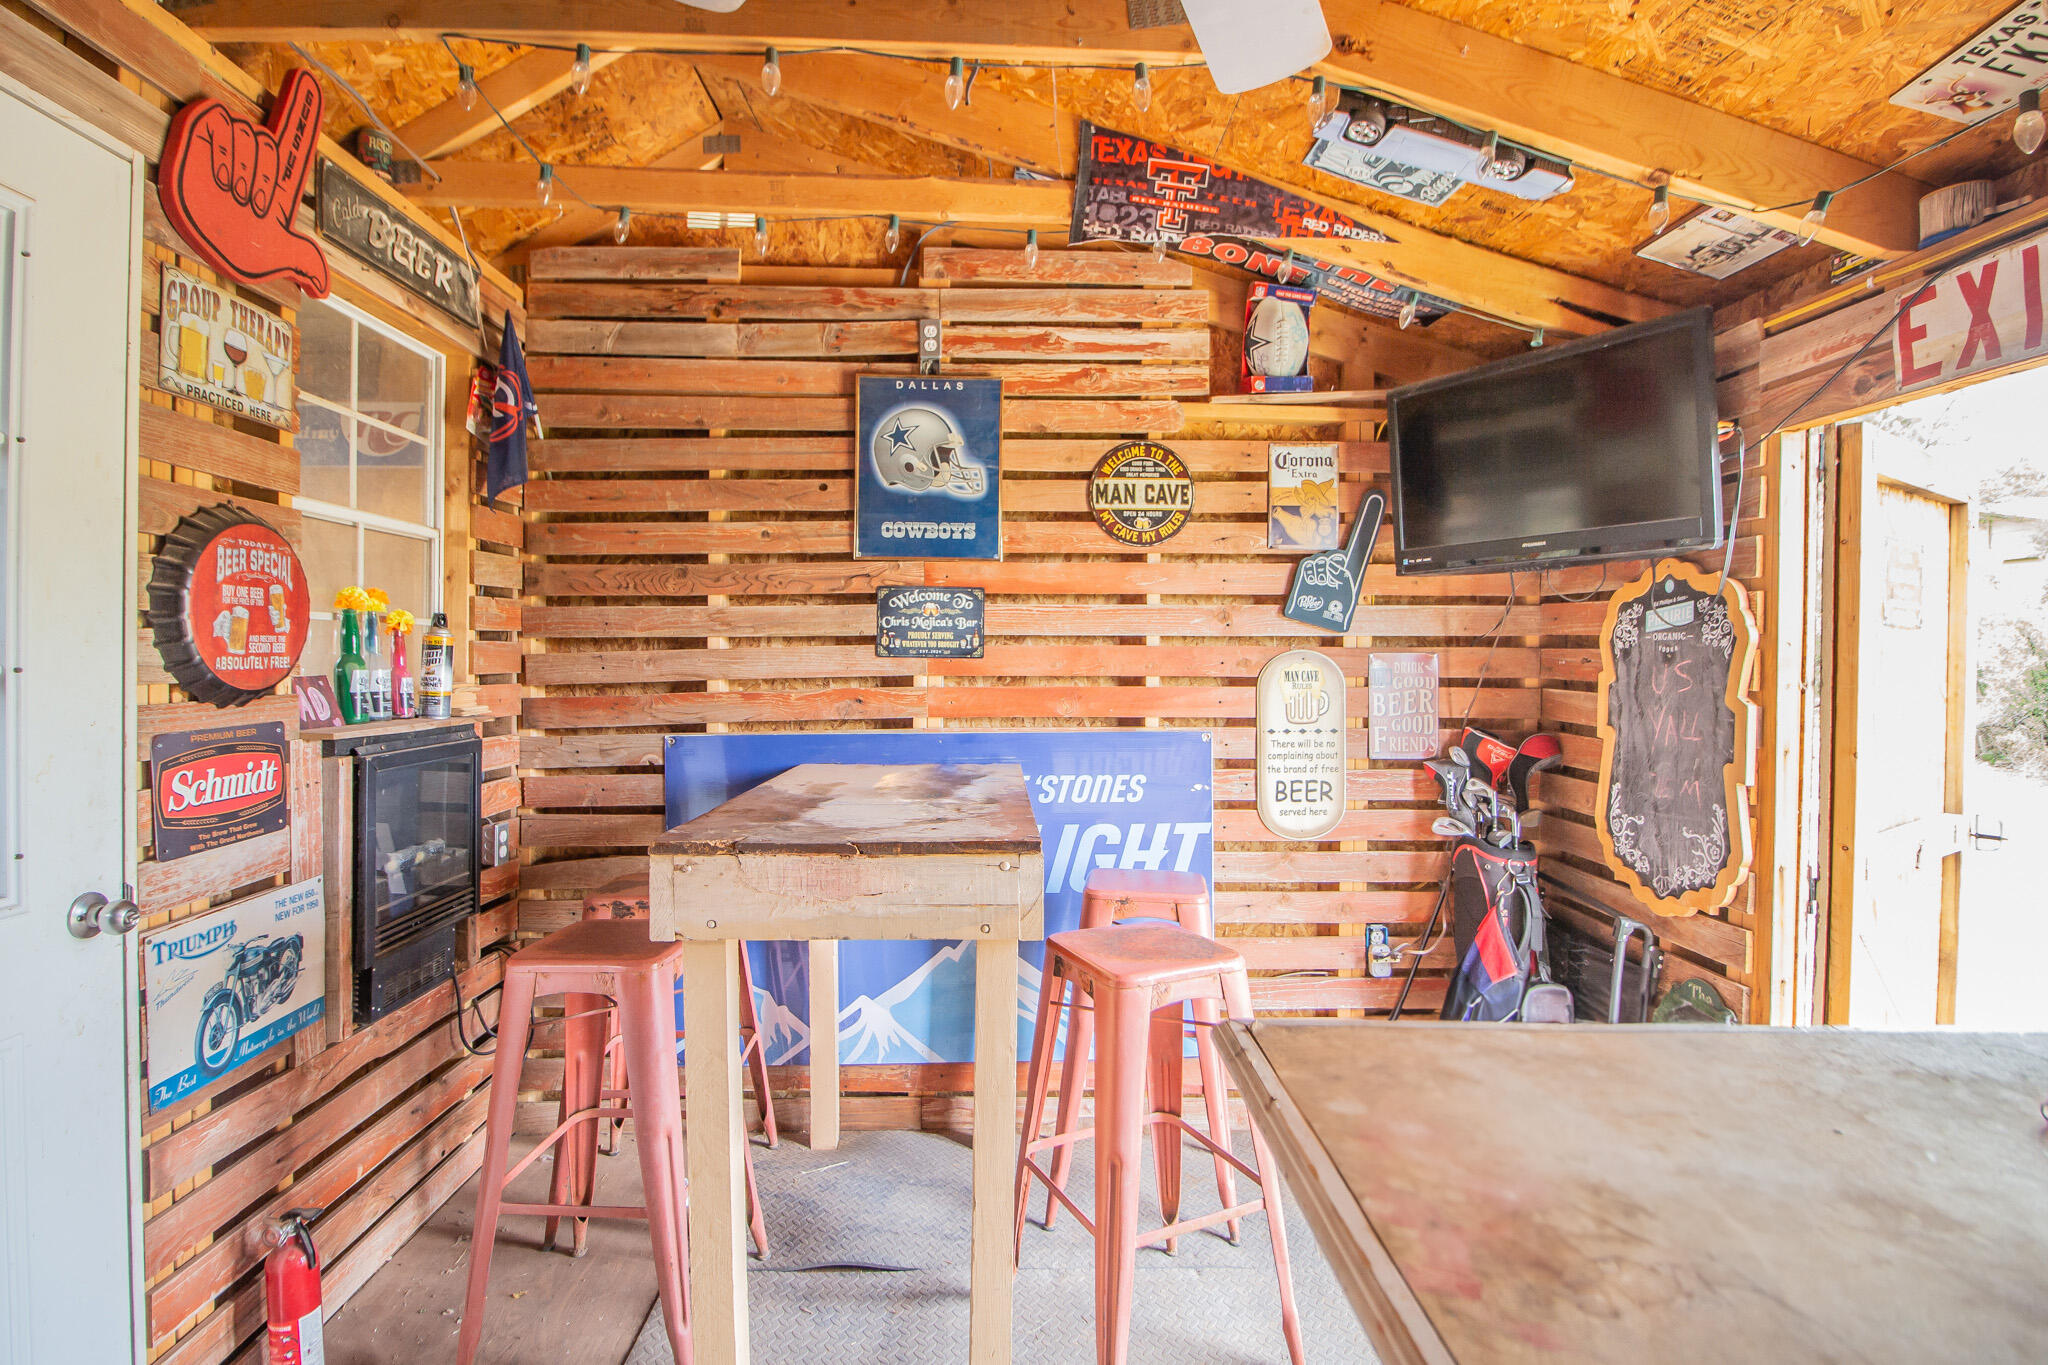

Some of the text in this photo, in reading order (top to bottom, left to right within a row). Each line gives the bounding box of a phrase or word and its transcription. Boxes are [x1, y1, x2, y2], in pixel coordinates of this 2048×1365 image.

[1951, 13, 2039, 65] TEXAS
[1980, 30, 2048, 78] FK1
[1090, 135, 1167, 166] TEXAS
[332, 195, 361, 229] Cold
[1302, 217, 1329, 232] RED
[1332, 222, 1387, 243] RAIDERS
[365, 208, 453, 295] BEER
[166, 279, 290, 361] GROUP THERAPY
[895, 380, 964, 391] DALLAS
[186, 384, 272, 422] PRACTICED HERE
[1100, 445, 1184, 476] WELCOME TO THE
[1274, 451, 1334, 471] Corona
[1291, 468, 1318, 478] Extra
[1095, 483, 1190, 505] MAN CAVE
[880, 521, 977, 540] COWBOYS
[1100, 510, 1185, 543] MY CAVE MY RULES
[237, 538, 275, 550] TODAY'S
[216, 544, 294, 592] BEER SPECIAL
[222, 584, 264, 599] BUY ONE BEER
[888, 589, 974, 610] Welcome To
[881, 615, 978, 630] Chris Mojica's Bar
[907, 631, 954, 639] PROUDLY SERVING
[1652, 632, 1686, 641] ORGANIC
[248, 642, 286, 653] SECOND BEER
[215, 656, 291, 671] ABSOLUTELY FREE!
[1394, 661, 1424, 674] DRINK
[1284, 670, 1319, 682] MAN CAVE
[1392, 675, 1436, 690] GOOD
[1651, 659, 1693, 695] US
[1291, 682, 1313, 690] RULES
[1372, 688, 1435, 717] BEER
[1391, 714, 1434, 735] GOOD
[190, 728, 257, 743] PREMIUM BEER
[1271, 739, 1295, 748] There
[1297, 739, 1311, 748] will
[1313, 739, 1324, 748] be
[1373, 726, 1437, 754] FRIENDS
[1267, 751, 1338, 762] complaining about
[1267, 764, 1339, 774] the brand of free
[168, 759, 279, 812] Schmidt
[1275, 779, 1333, 803] BEER
[1279, 807, 1328, 816] served here
[228, 825, 242, 833] That
[219, 835, 236, 844] Great
[1040, 822, 1212, 894] IGHT
[274, 897, 287, 909] THE
[288, 892, 303, 904] NEW
[274, 909, 291, 922] NEW
[291, 904, 305, 916] FOR
[151, 919, 237, 966] TRIUMPH
[153, 1086, 173, 1106] The
[177, 1073, 197, 1093] Best
